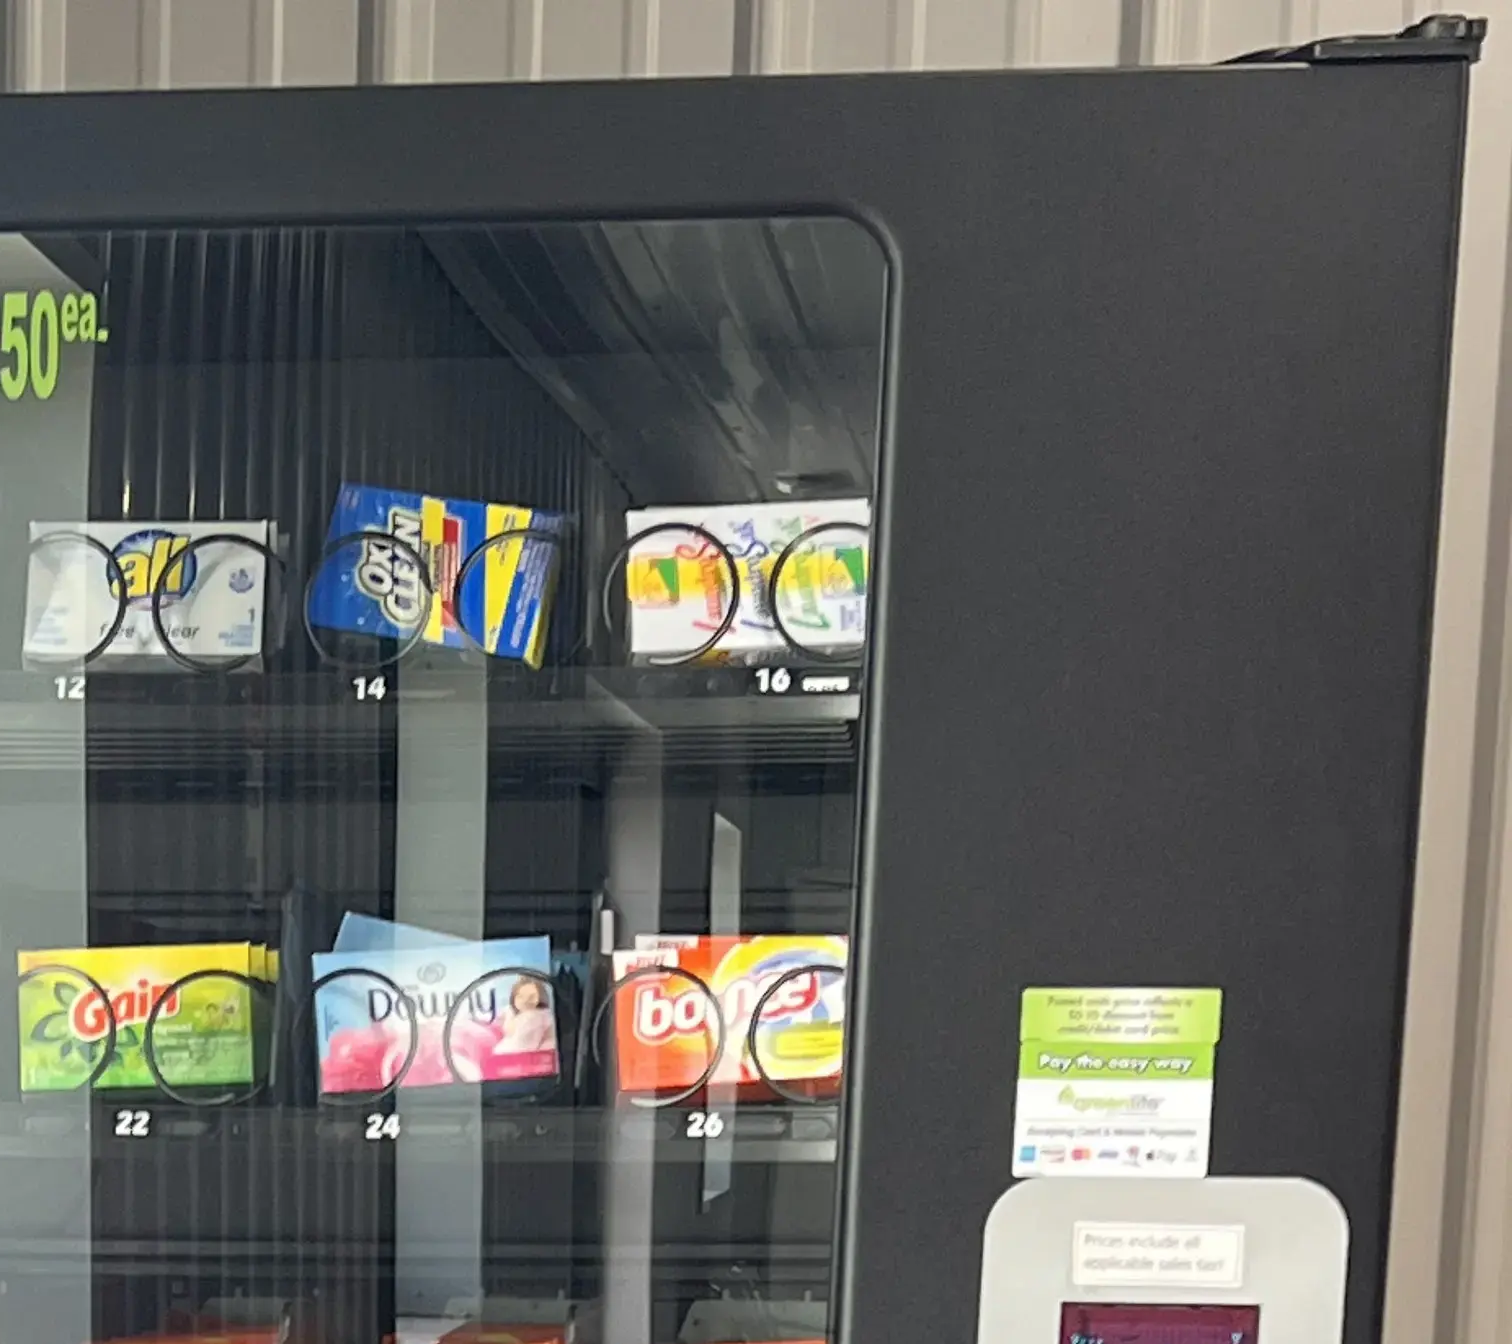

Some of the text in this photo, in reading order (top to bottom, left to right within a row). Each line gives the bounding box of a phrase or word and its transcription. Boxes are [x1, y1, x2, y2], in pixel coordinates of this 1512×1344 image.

[110, 535, 192, 599] all
[54, 676, 86, 699] 12
[353, 675, 387, 700] 14
[755, 667, 791, 693] 16
[72, 978, 180, 1037] Gain
[1039, 1052, 1194, 1074] Pay the easy way
[115, 1109, 151, 1136] 22
[365, 1113, 401, 1139] 24
[686, 1111, 724, 1138] 26
